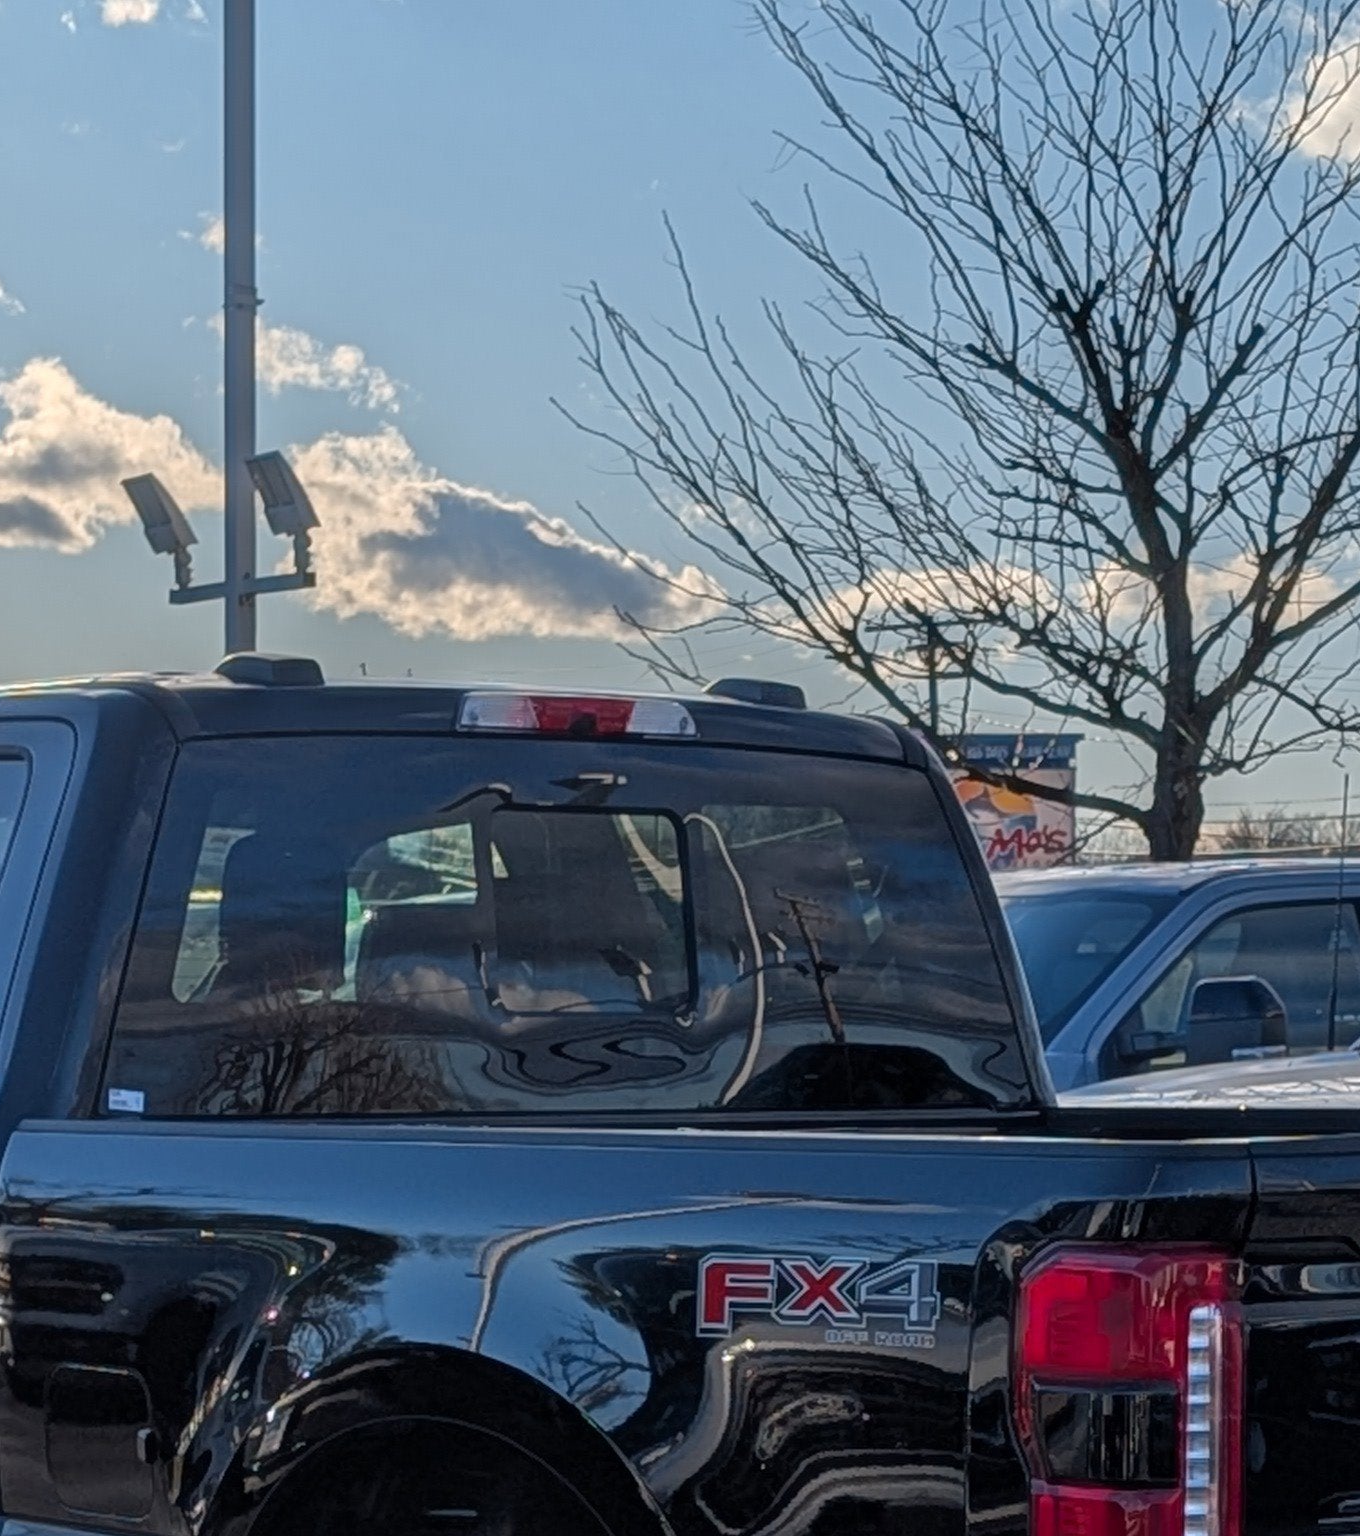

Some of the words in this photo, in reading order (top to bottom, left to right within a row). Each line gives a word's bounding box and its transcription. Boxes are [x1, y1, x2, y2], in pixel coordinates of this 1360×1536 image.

[986, 825, 1068, 859] Mo's
[696, 1252, 939, 1337] FX4
[824, 1328, 869, 1345] OFF
[874, 1330, 936, 1349] ROAD
